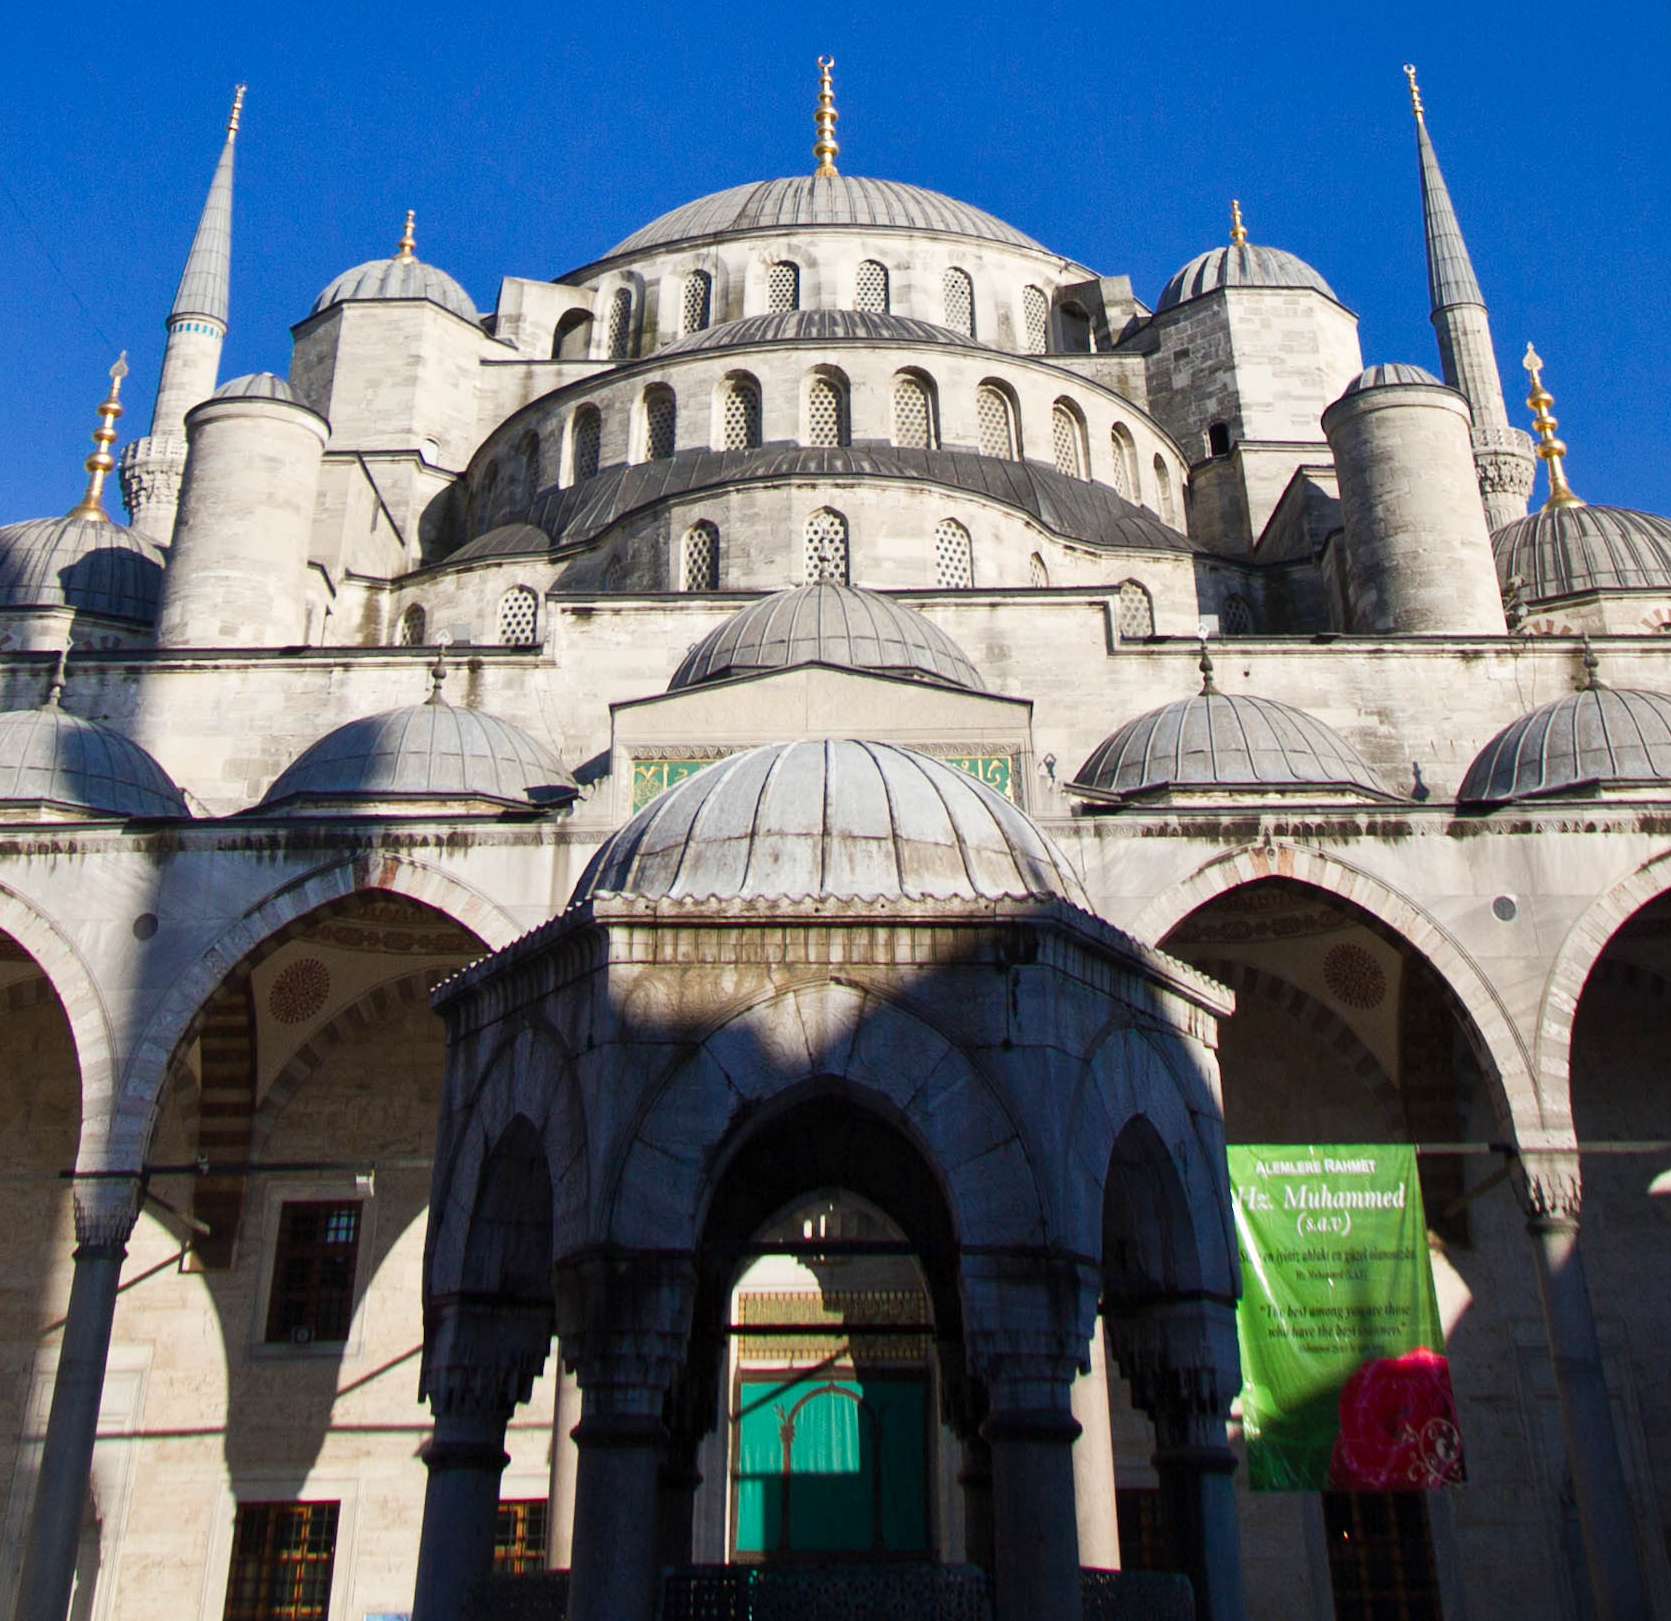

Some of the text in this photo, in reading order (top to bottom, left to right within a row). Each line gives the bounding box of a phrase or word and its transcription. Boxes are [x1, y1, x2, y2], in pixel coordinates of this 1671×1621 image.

[1256, 1159, 1376, 1175] ALEMLERE RAHMET
[1238, 1183, 1405, 1210] Hz. Muhammed
[1297, 1211, 1352, 1238] (s.a.v)
